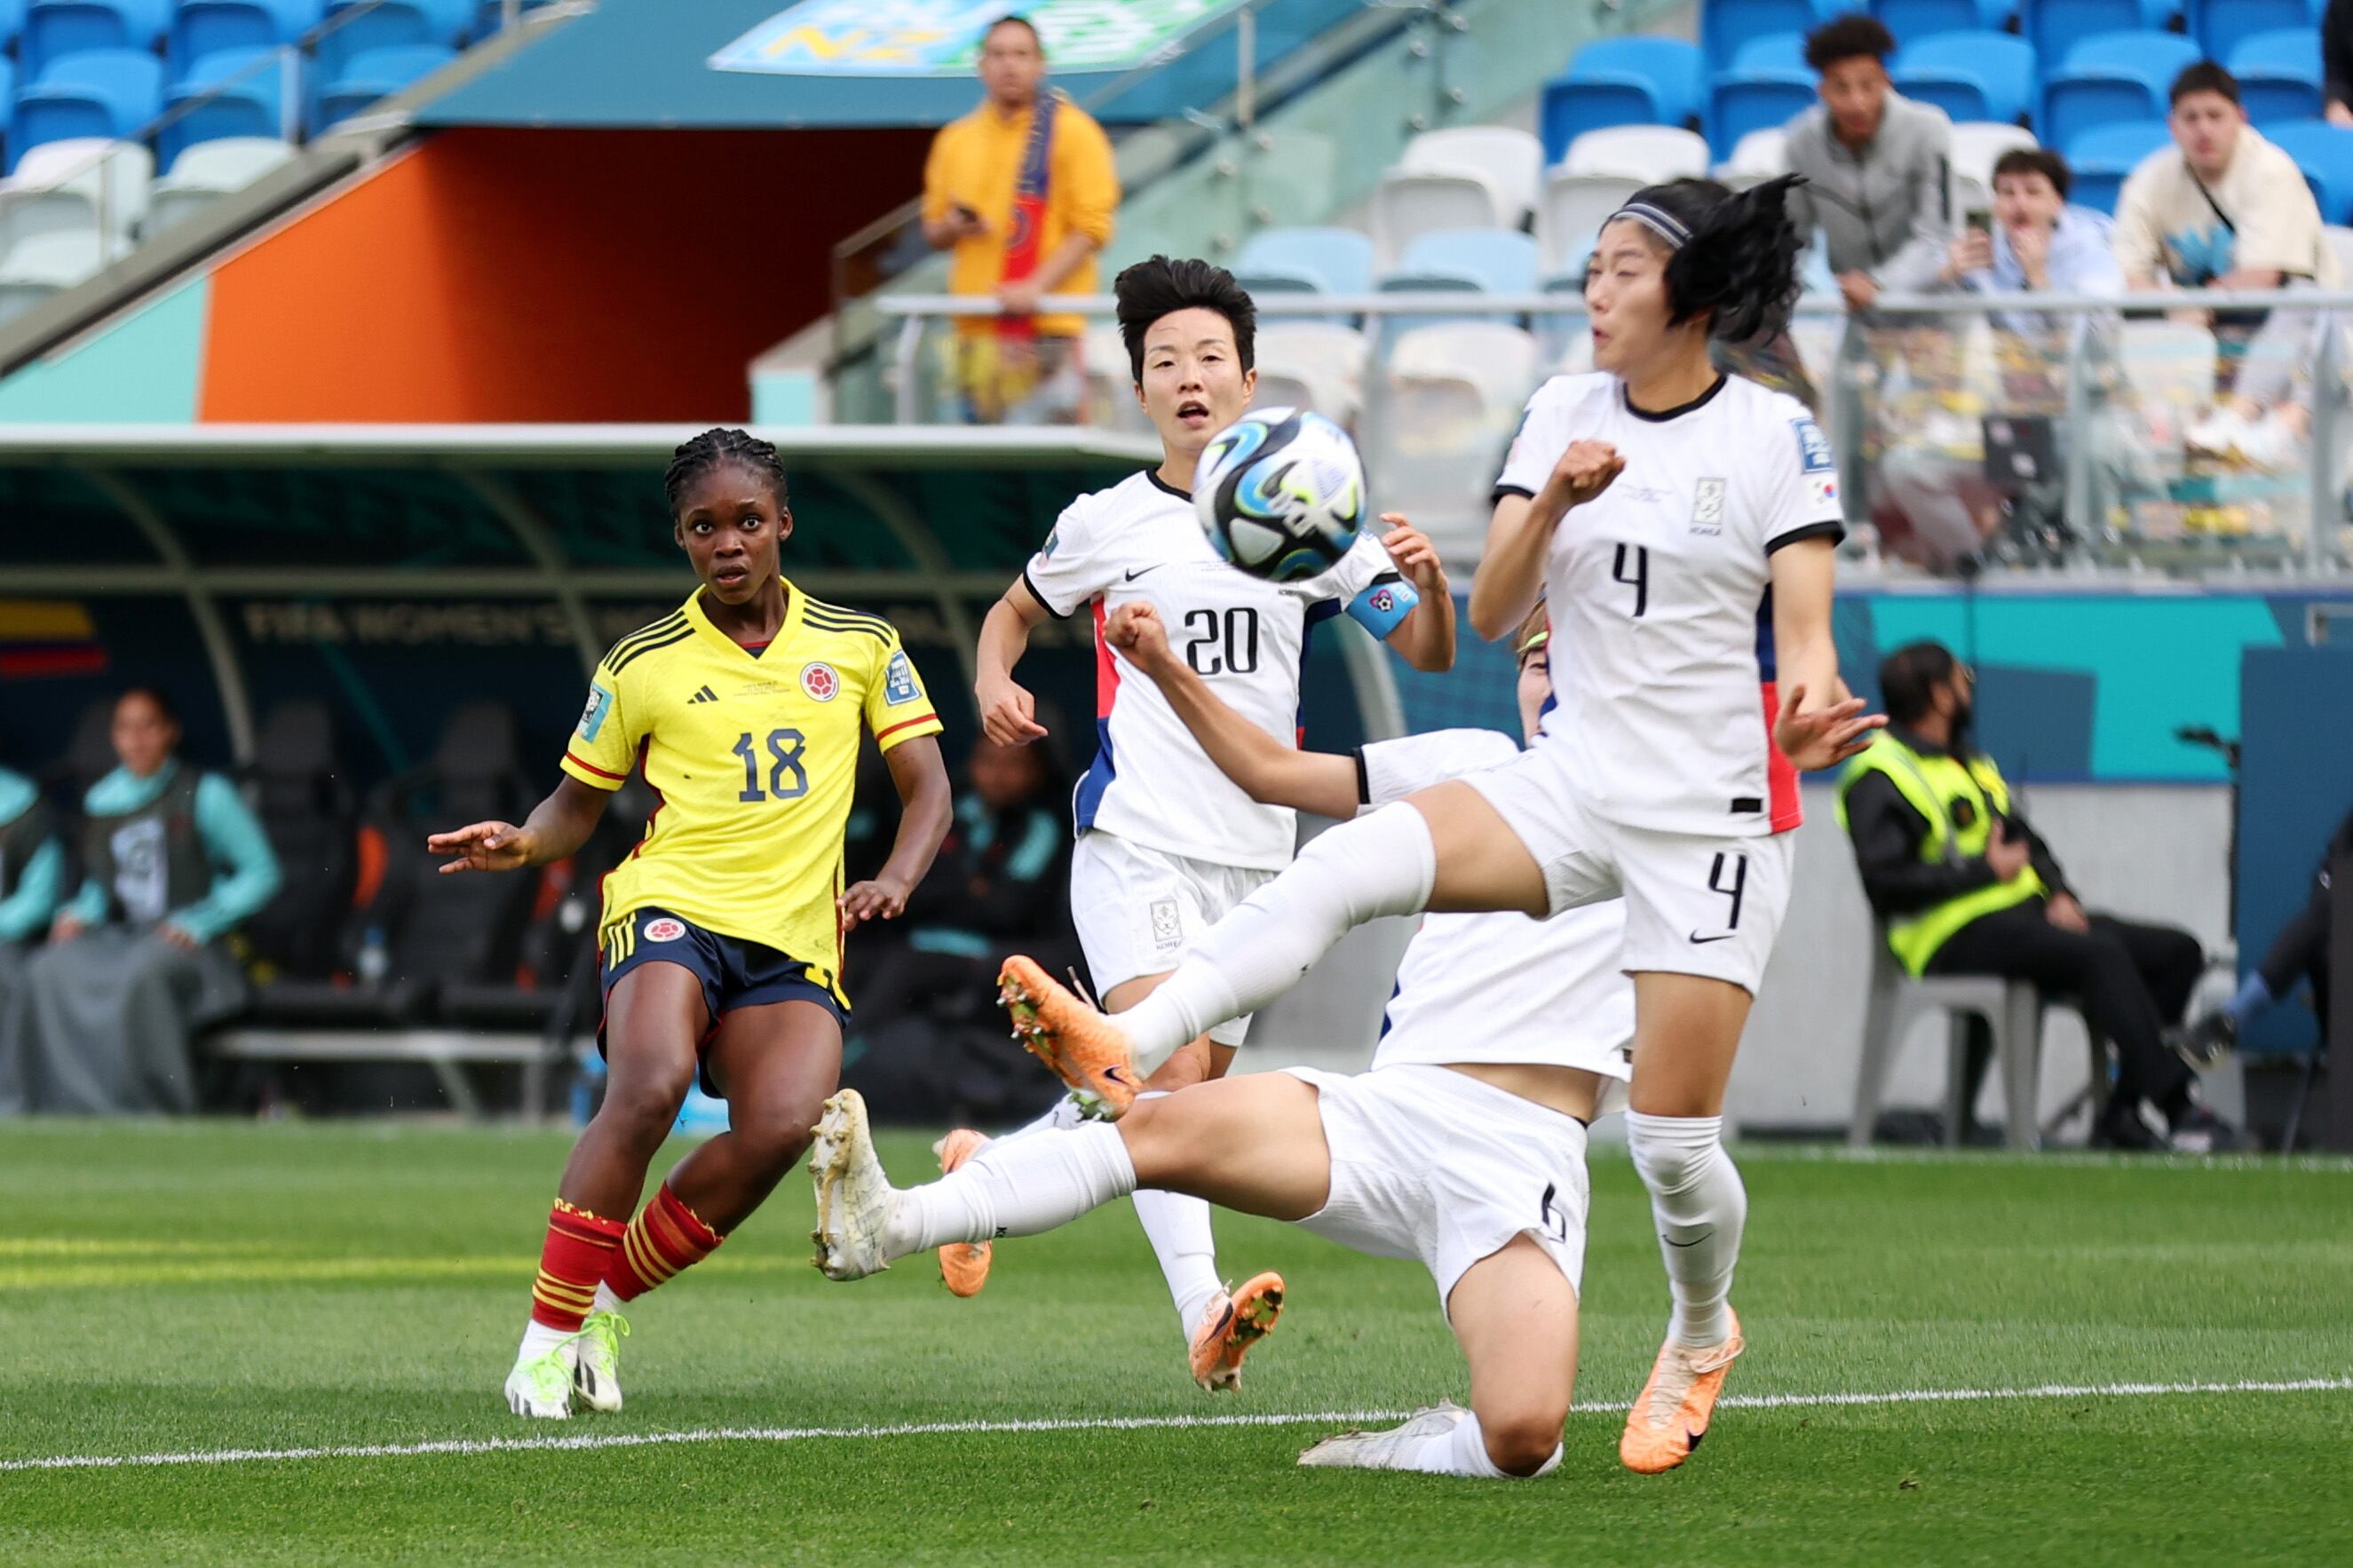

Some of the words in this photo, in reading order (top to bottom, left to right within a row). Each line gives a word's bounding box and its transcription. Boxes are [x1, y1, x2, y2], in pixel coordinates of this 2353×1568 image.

[1612, 542, 1647, 617] 4
[1184, 607, 1258, 675] 20
[732, 728, 809, 802] 18
[1708, 852, 1747, 930] 4
[1541, 1182, 1566, 1243] 6
